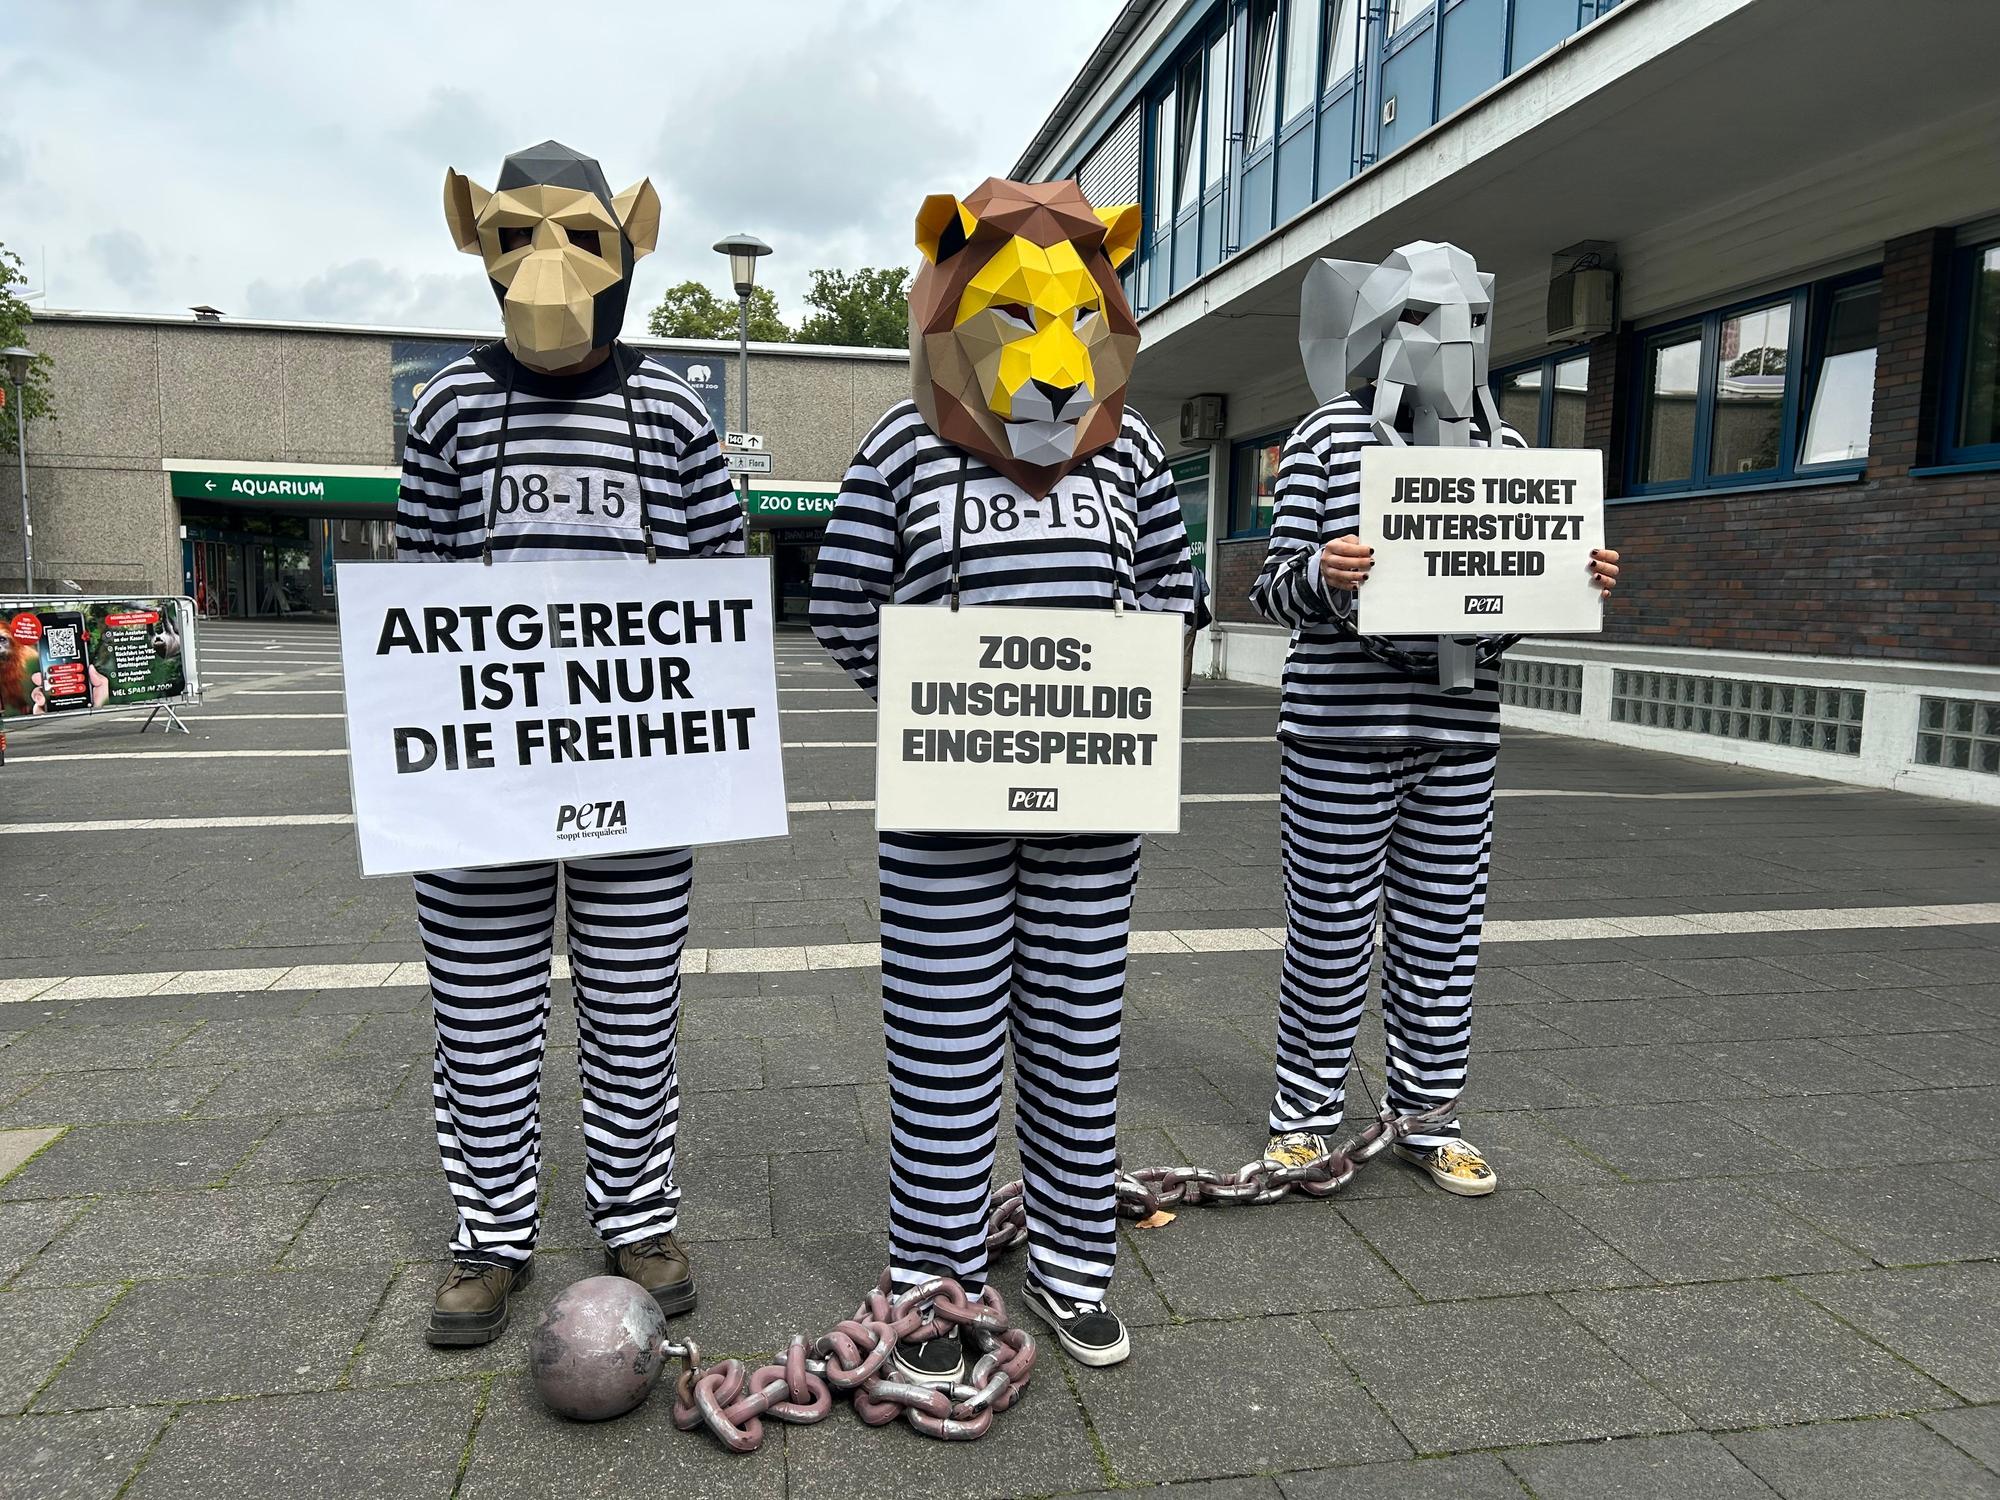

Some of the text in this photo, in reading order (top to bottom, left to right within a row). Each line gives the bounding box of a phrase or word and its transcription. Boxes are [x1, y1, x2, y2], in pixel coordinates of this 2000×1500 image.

[729, 435, 743, 445] 140
[748, 459, 765, 467] Flora
[231, 479, 325, 496] AQUARIUM
[498, 474, 625, 518] 08-15
[1391, 477, 1577, 505] JEDES TICKET
[760, 496, 792, 510] ZOO
[961, 493, 1100, 534] 08-15
[1383, 512, 1584, 541] UNTERSTÜTZT
[1424, 551, 1545, 577] TIERLEID
[1467, 598, 1502, 613] PeTA
[376, 599, 753, 655] ARTGERECHT
[979, 635, 1092, 672] ZOOS:
[112, 688, 127, 697] VIEL
[460, 656, 694, 711] IST NUR
[911, 681, 1152, 720] UNSCHULDIG
[393, 707, 756, 774] DIE FREIHEIT
[902, 729, 1158, 766] EINGESPERRT
[1012, 791, 1055, 808] PeTA
[556, 800, 626, 831] PeTA
[556, 826, 628, 841] stoppt tierquälerei!
